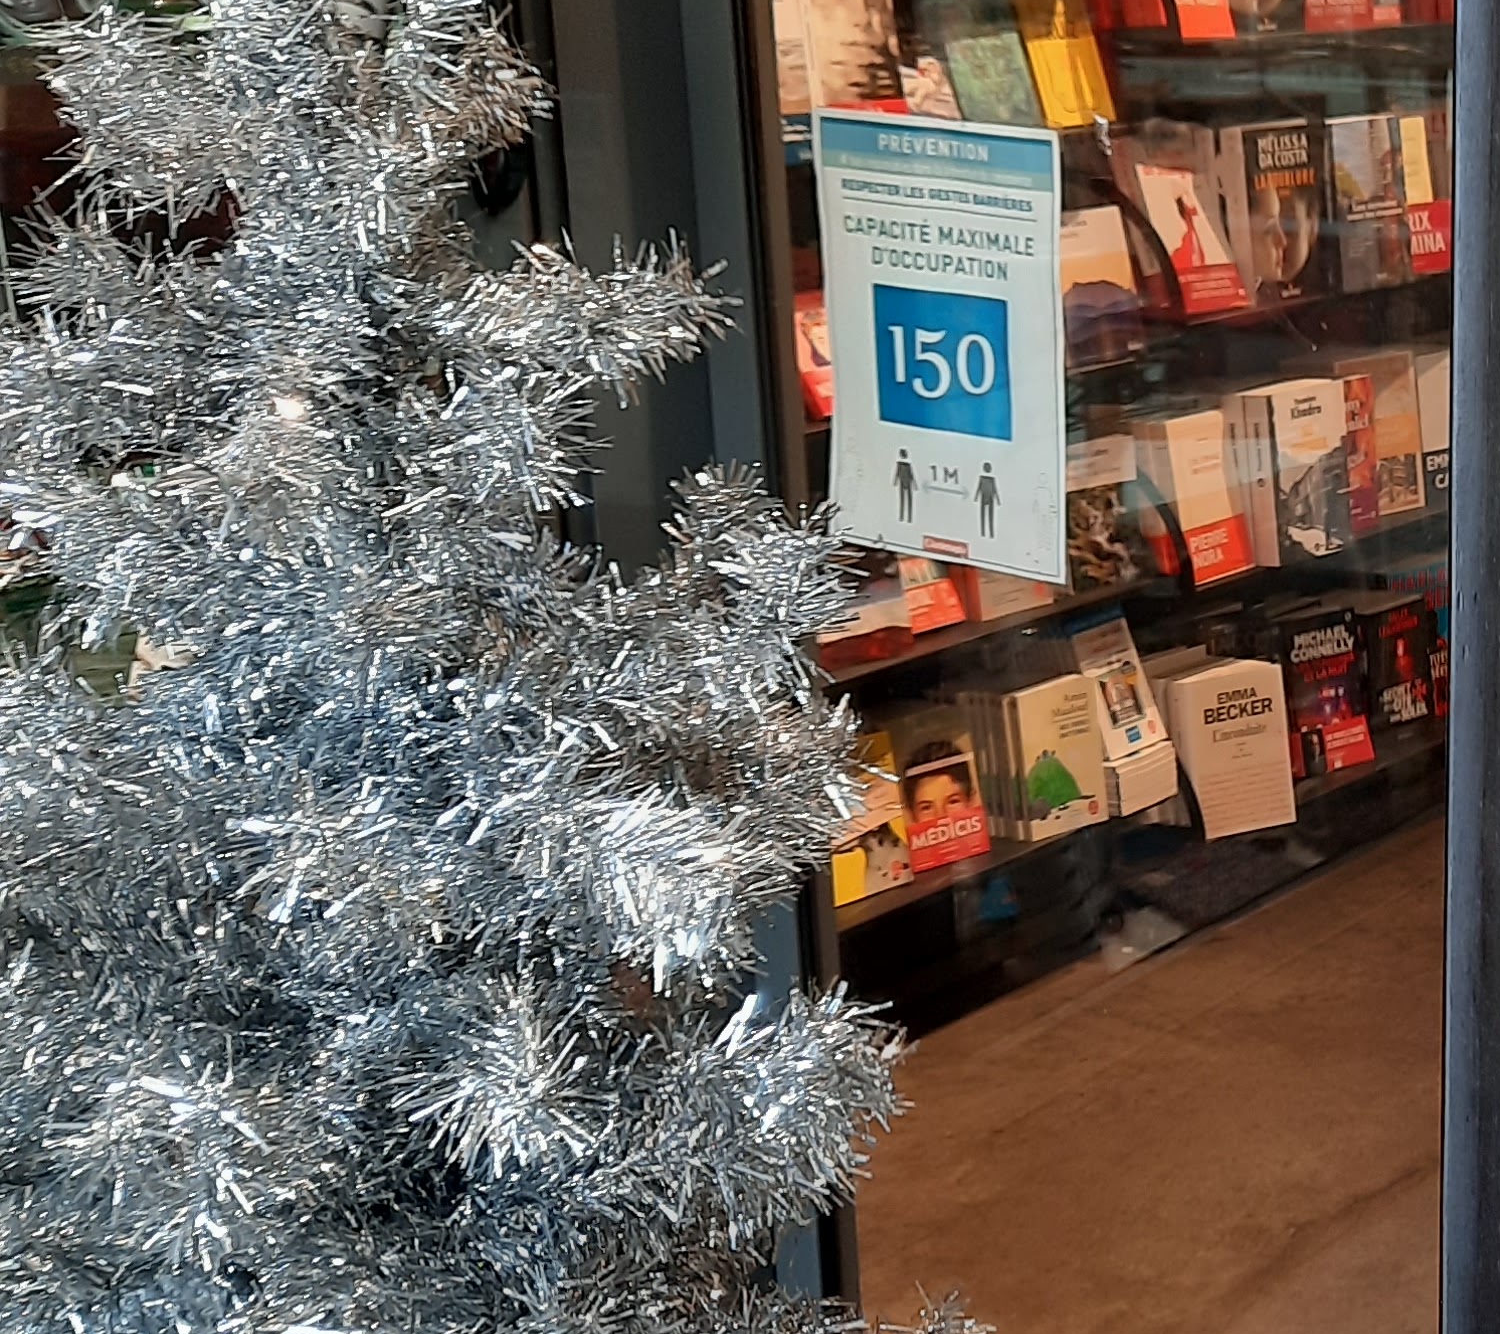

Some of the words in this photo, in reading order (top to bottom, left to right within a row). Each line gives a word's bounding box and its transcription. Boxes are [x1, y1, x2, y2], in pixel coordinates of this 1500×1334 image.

[877, 132, 989, 162] PRÉVENTION
[1257, 133, 1308, 153] MÉLISSA
[1259, 153, 1273, 169] DA
[1275, 150, 1308, 167] COSTA
[904, 186, 924, 199] LES
[844, 215, 931, 244] CAPACITÉ
[938, 226, 1035, 257] MAXIMALE
[872, 246, 1008, 281] D'OCCUPATION
[888, 325, 995, 399] 150
[943, 467, 959, 485] M
[1290, 636, 1355, 663] CONNELLY
[1294, 624, 1349, 650] MICHAEL
[1217, 687, 1258, 705] EMMA
[1203, 698, 1273, 725] BECKER
